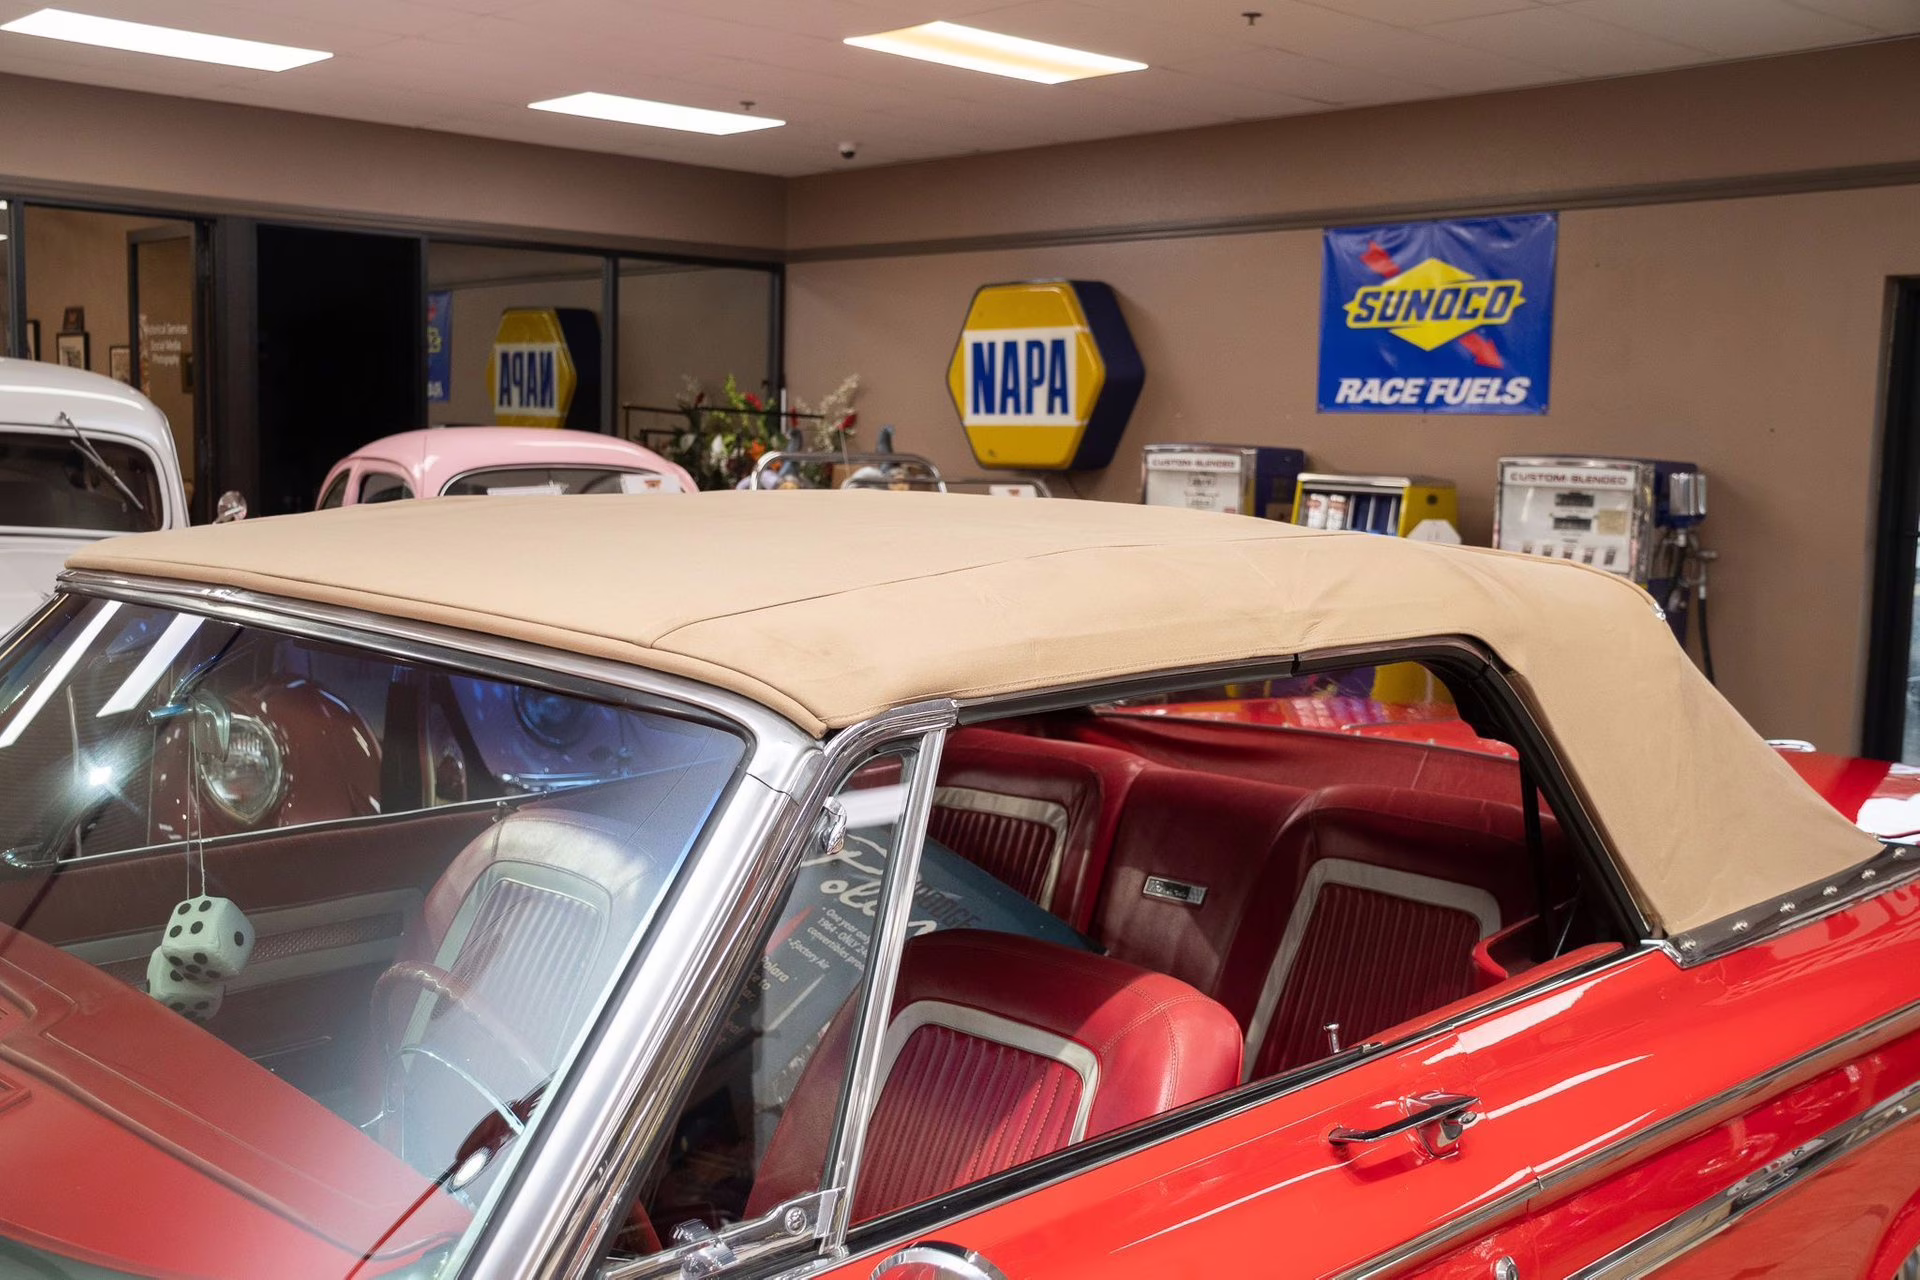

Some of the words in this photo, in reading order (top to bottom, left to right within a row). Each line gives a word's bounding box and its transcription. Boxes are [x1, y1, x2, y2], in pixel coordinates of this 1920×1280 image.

[1353, 285, 1516, 323] SUNOCO
[972, 339, 1069, 415] NAPA
[1334, 377, 1428, 404] RACE
[1424, 376, 1532, 405] FUELS
